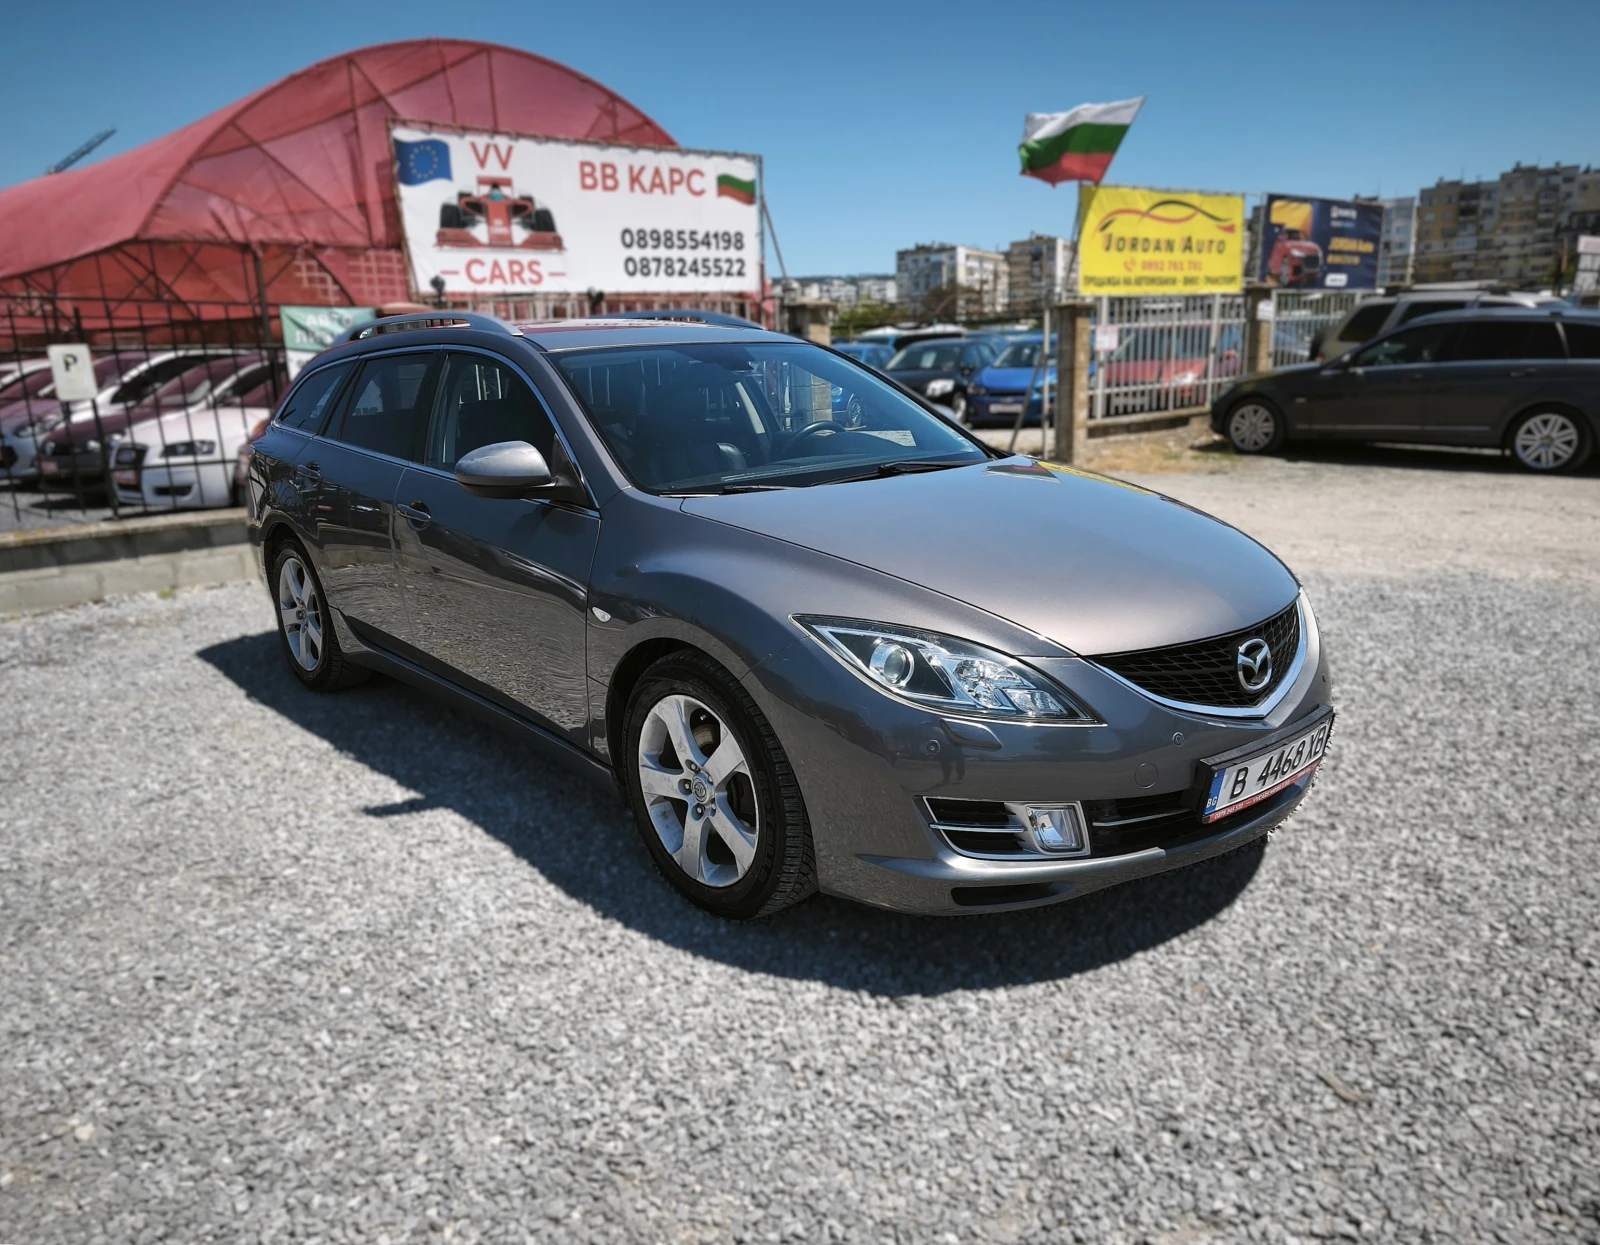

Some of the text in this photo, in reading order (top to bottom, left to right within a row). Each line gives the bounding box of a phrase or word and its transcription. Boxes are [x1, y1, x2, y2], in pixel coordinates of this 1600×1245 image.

[470, 141, 514, 171] VV
[628, 164, 706, 197] КАРС
[621, 228, 744, 251] 0898554198
[465, 258, 544, 285] CARS
[624, 257, 746, 278] 0878245522
[1229, 766, 1249, 800] B
[1257, 740, 1306, 786] 4468
[1304, 725, 1327, 763] XB
[1206, 796, 1218, 809] BG
